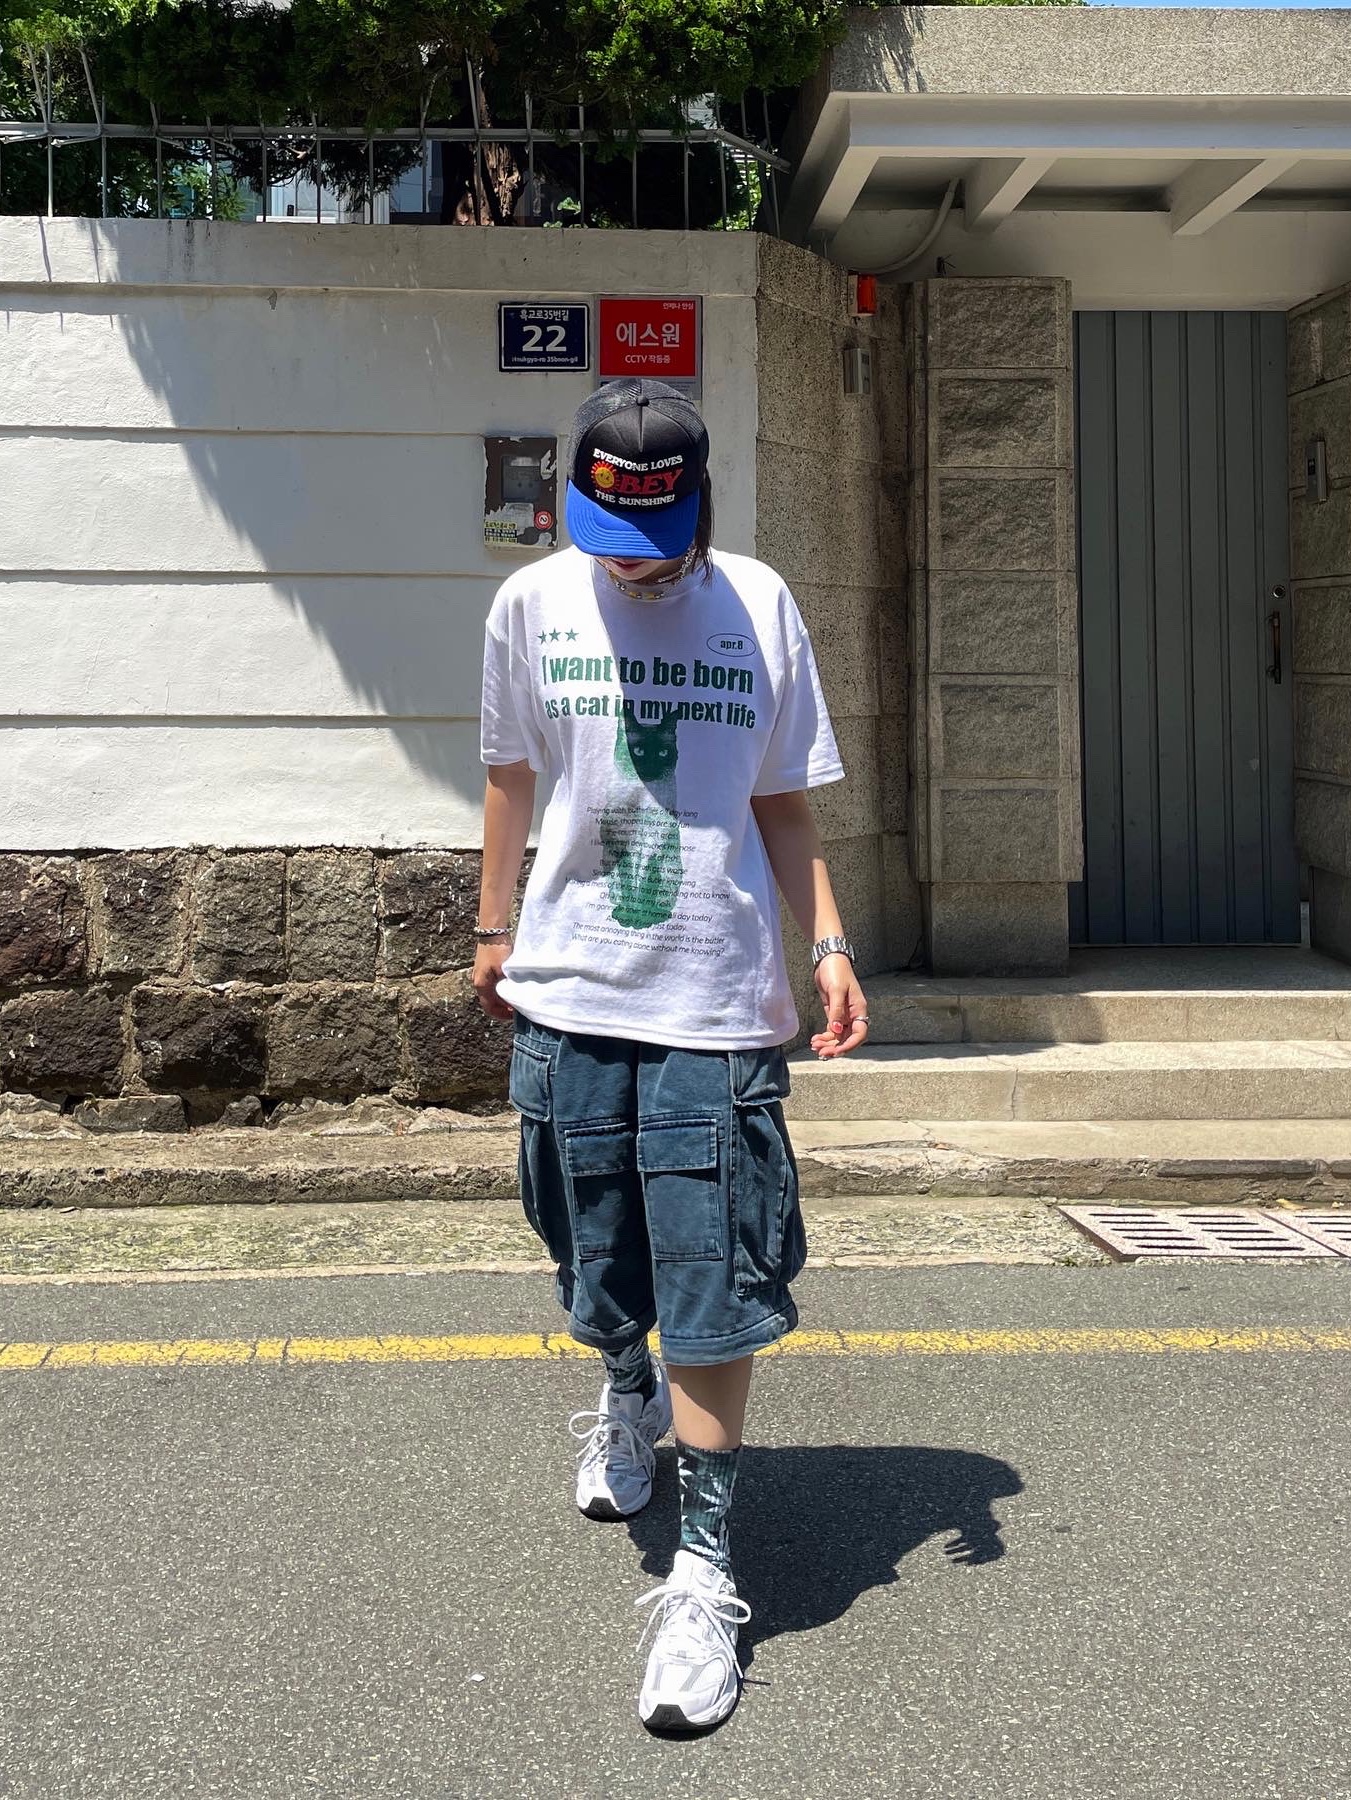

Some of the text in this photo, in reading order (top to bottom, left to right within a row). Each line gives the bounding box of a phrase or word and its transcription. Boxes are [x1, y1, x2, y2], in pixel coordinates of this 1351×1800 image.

[522, 325, 567, 352] 22
[616, 322, 680, 349] 에스원
[625, 354, 647, 363] CCTV
[593, 448, 683, 471] EVERYONE LOVES
[595, 489, 676, 506] THE SUNSHINE!
[720, 640, 744, 651] apr.8
[541, 655, 754, 694] I want to be born
[545, 695, 756, 730] as a cat in my next life
